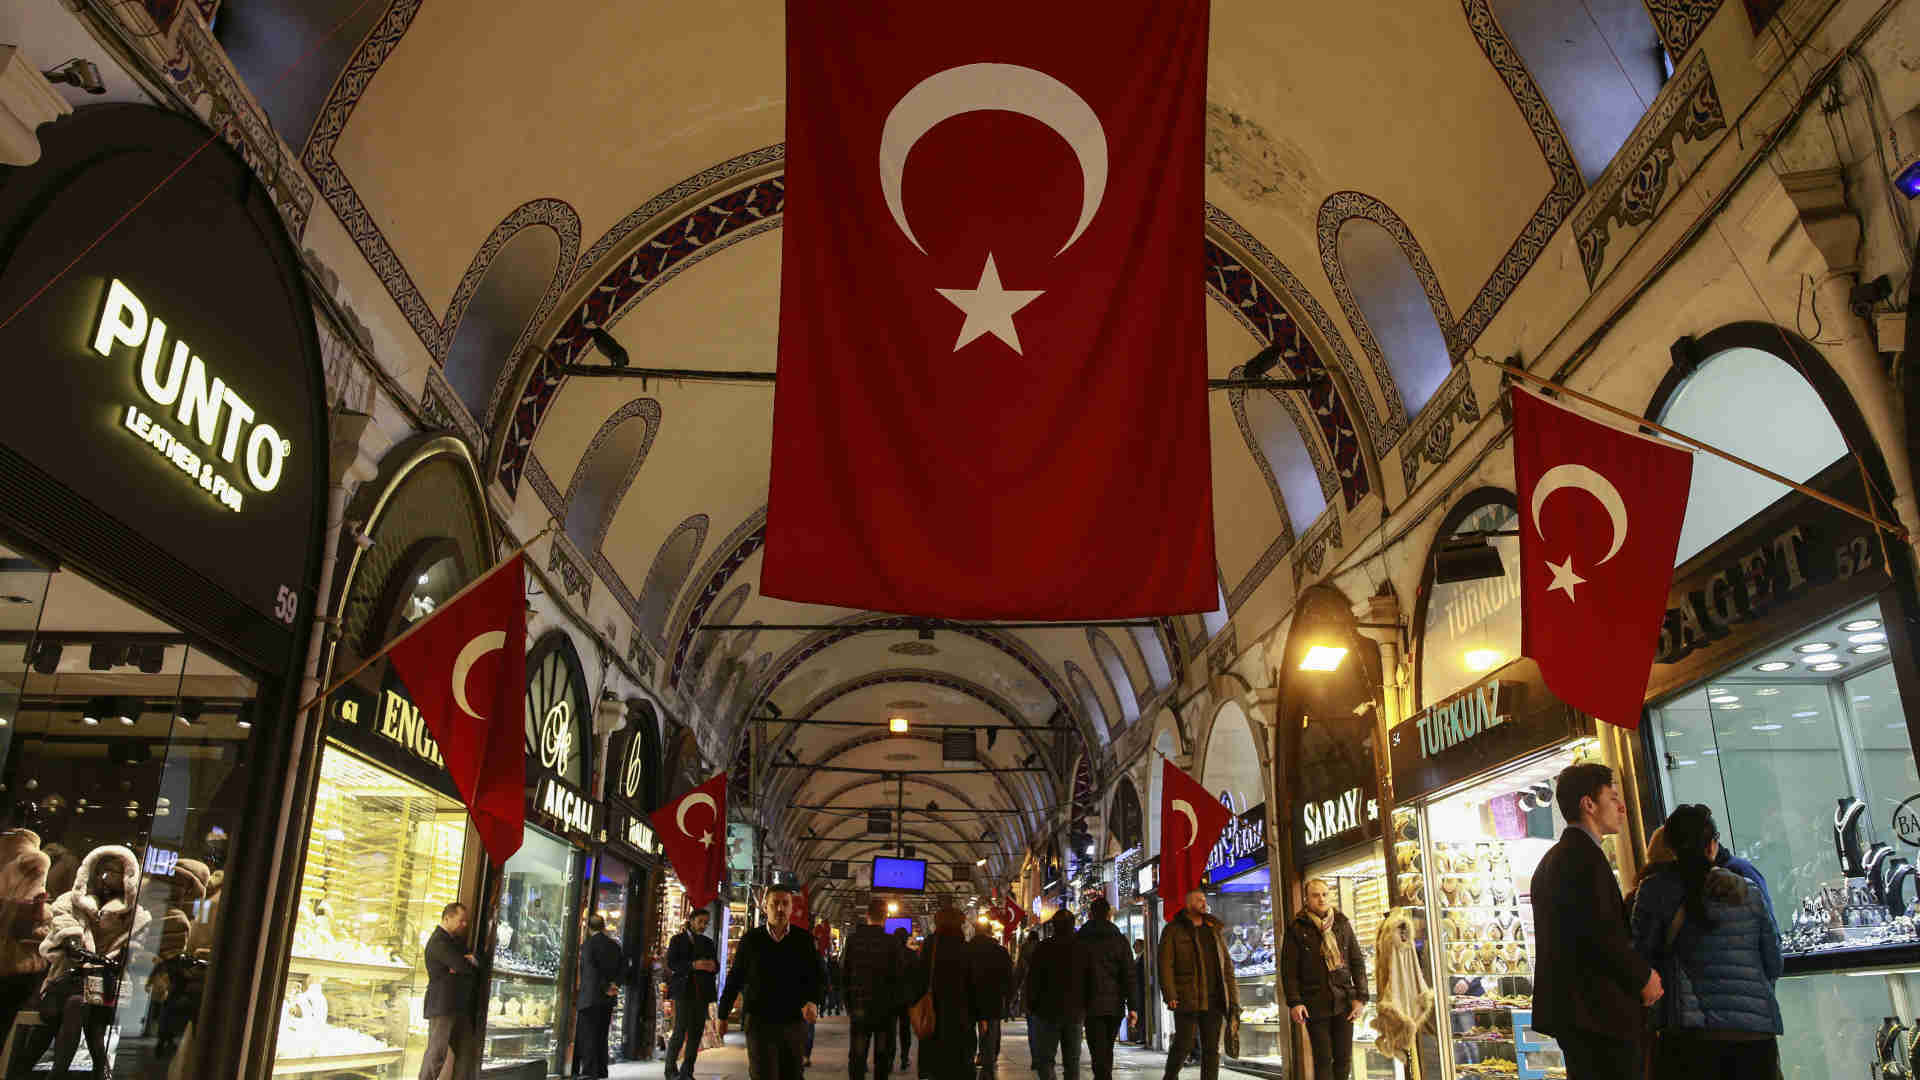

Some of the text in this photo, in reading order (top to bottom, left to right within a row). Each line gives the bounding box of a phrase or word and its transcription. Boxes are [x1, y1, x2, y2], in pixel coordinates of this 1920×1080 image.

[94, 278, 284, 491] PUNTO
[125, 405, 243, 512] LEATHER & FUR
[1835, 535, 1872, 582] 52
[274, 584, 298, 623] 59
[341, 700, 359, 724] 61
[1416, 679, 1504, 760] TÜRKUAZ
[543, 779, 593, 834] AKÇALI
[1303, 788, 1361, 846] SARAY
